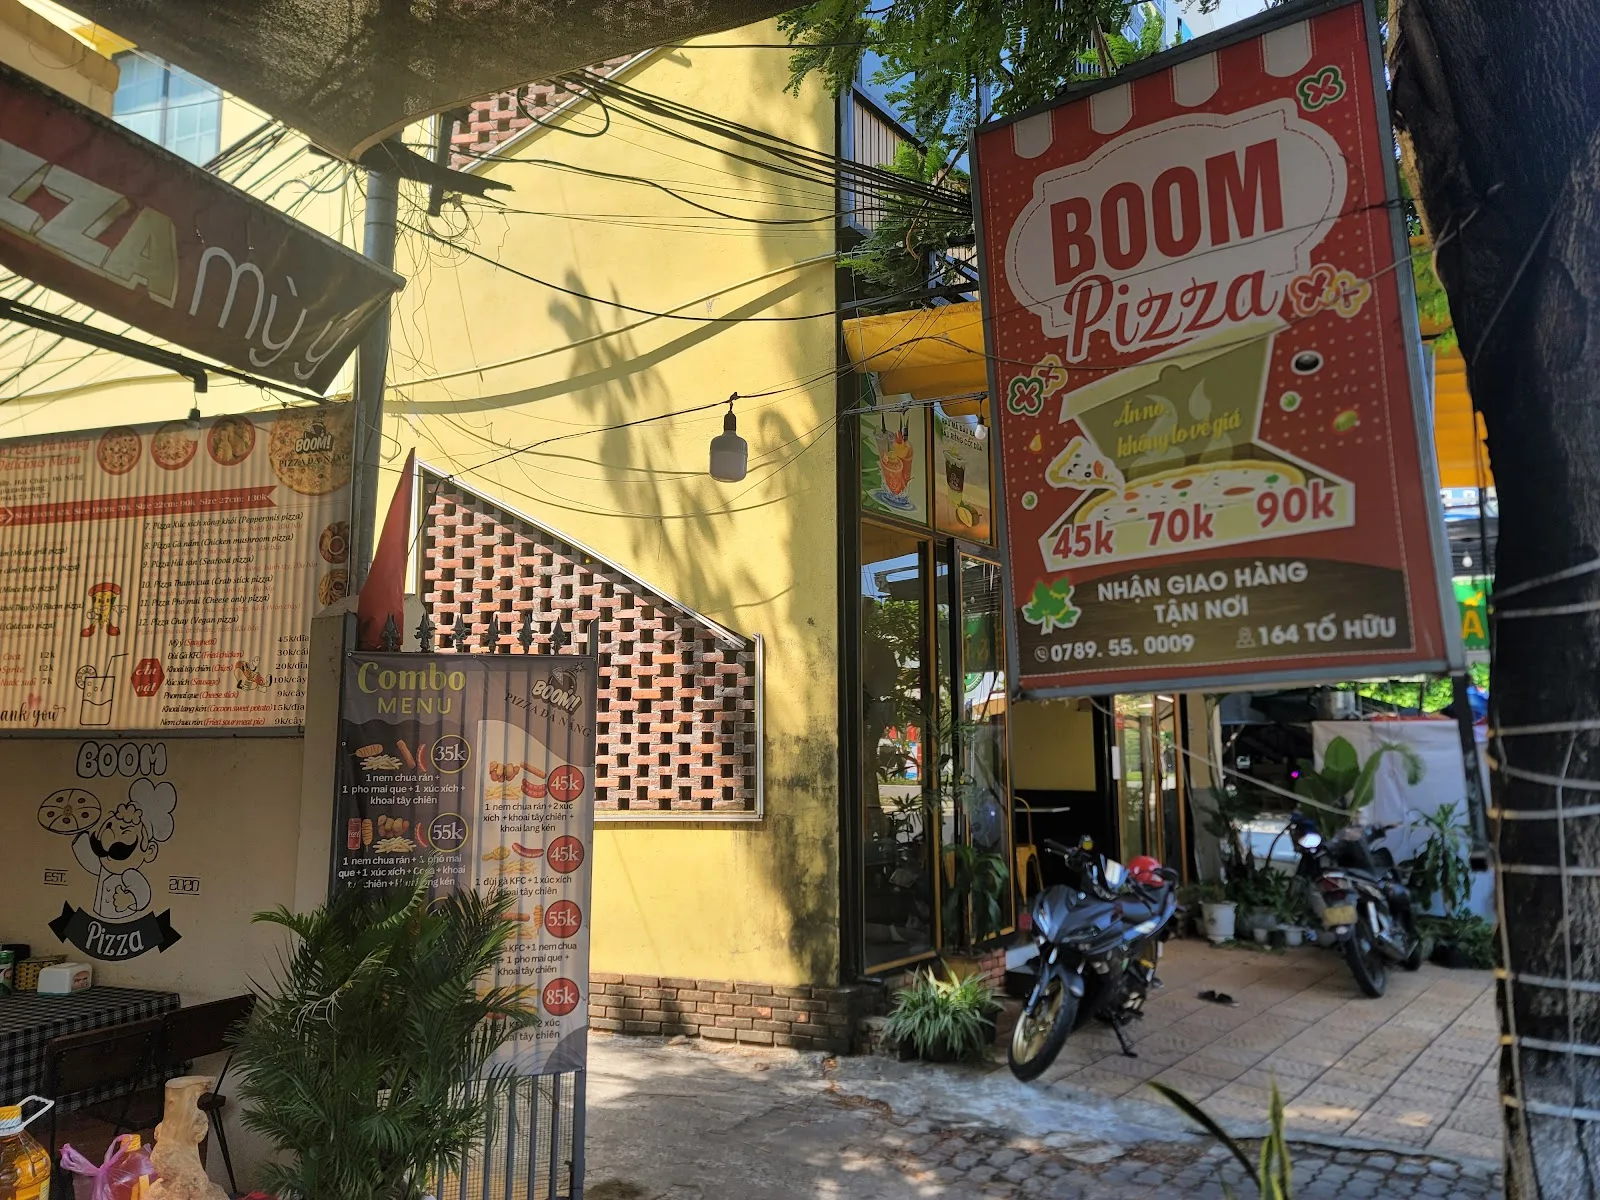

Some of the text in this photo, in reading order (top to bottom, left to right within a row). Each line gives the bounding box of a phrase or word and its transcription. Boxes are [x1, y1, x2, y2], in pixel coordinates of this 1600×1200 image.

[1049, 137, 1285, 287] BOOM
[1063, 269, 1278, 358] Pizza
[1113, 398, 1142, 428] Ăn
[1171, 422, 1187, 444] lo
[1212, 408, 1242, 438] giá
[295, 433, 333, 454] BOOM!
[199, 497, 217, 505] Size
[280, 511, 304, 523] pizza)
[1052, 478, 1334, 559] 45k 70k 90k
[271, 532, 294, 543] pizza)
[251, 574, 273, 585] pizza)
[1097, 561, 1308, 604] NHẬN GIAO HÀNG
[1153, 594, 1249, 628] TẬN NƠI
[216, 615, 239, 625] pizza)
[1258, 612, 1397, 646] 164 TỐ HỮU
[1050, 634, 1194, 662] 0789. 55. 0009
[358, 661, 466, 694] Combo
[504, 692, 538, 715] PIZZA
[531, 680, 582, 714] BOOM!
[377, 698, 451, 714] MENU
[32, 705, 66, 727] you
[76, 740, 167, 778] BOOM
[434, 743, 466, 761] 35k
[366, 774, 371, 782] 1
[394, 773, 417, 782] chua
[418, 773, 433, 782] rán
[550, 773, 580, 791] 45k
[342, 784, 459, 796] 1 pho mai que 1 xúc xích
[370, 795, 438, 807] khoai tây chiên
[508, 813, 530, 821] khoai
[531, 813, 544, 822] tây
[545, 813, 567, 821] chiên
[432, 822, 463, 840] 55k
[500, 824, 556, 833] khoai lang kén
[343, 857, 348, 866] 1
[351, 857, 371, 865] nem
[372, 856, 394, 865] chua
[395, 855, 410, 864] rán
[445, 854, 462, 863] mai
[550, 844, 580, 862] 45k
[43, 871, 67, 883] EST.
[338, 869, 355, 879] que
[362, 868, 368, 877] 1
[370, 868, 386, 877] xúc
[387, 867, 406, 876] xích
[442, 865, 466, 874] khoai
[168, 878, 200, 892] 2020
[439, 877, 455, 886] kén
[475, 878, 480, 886] 1
[498, 877, 508, 887] gà
[509, 876, 526, 885] KFC
[540, 876, 554, 884] xúc
[555, 875, 572, 883] xích
[520, 887, 533, 897] tây
[534, 887, 557, 895] chiên
[548, 909, 578, 927] 55k
[85, 920, 145, 957] Pizza
[508, 944, 525, 953] KFC
[557, 942, 577, 950] chua
[514, 955, 530, 965] pho
[531, 955, 546, 963] mai
[547, 954, 563, 963] que
[497, 966, 557, 976] Khoai tây chiên
[546, 986, 576, 1005] 85k
[538, 1020, 544, 1028] 2
[544, 1019, 560, 1027] xúc
[519, 1031, 533, 1042] tây
[535, 1031, 560, 1039] chiên
